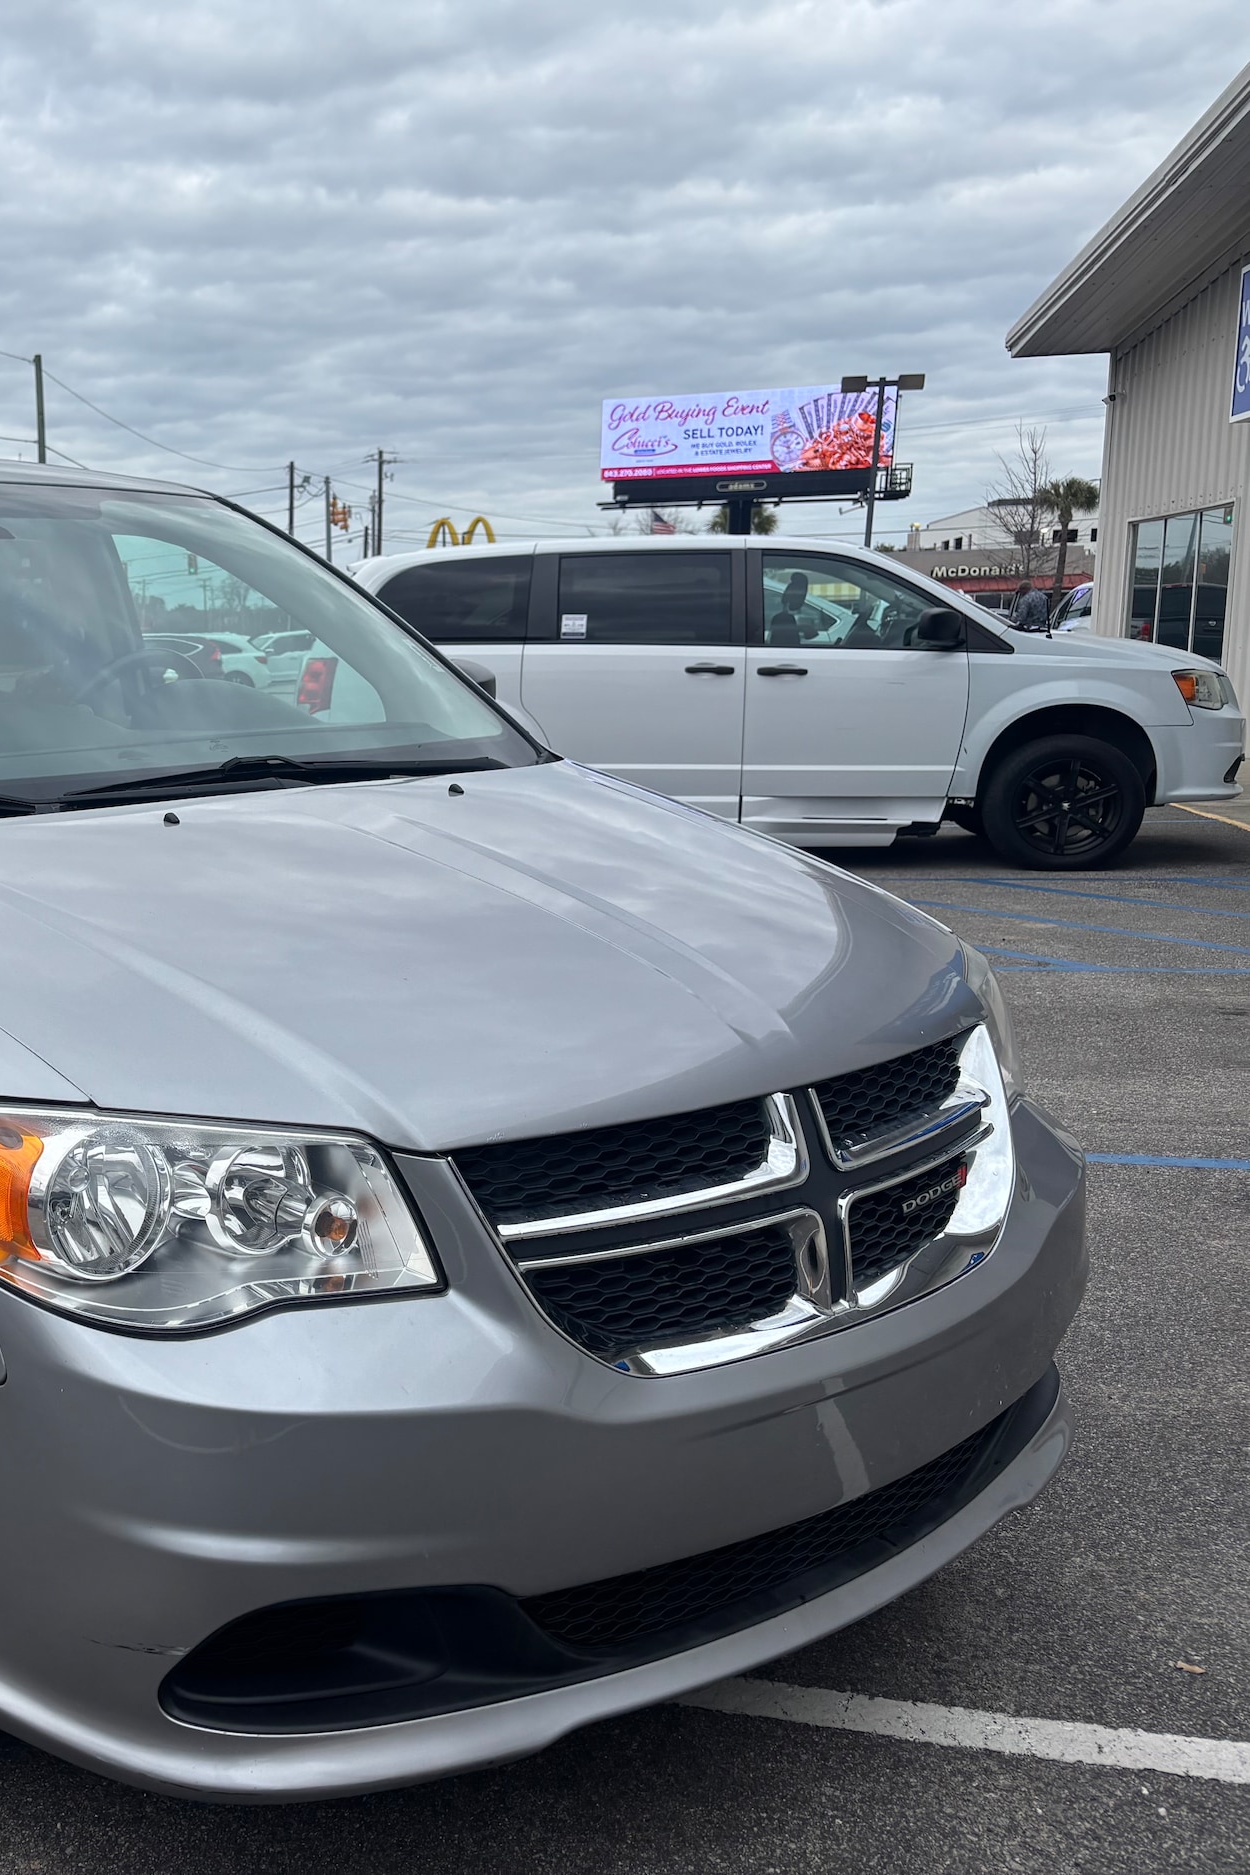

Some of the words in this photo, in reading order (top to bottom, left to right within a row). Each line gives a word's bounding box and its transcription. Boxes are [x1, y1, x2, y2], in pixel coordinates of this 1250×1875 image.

[608, 404, 651, 430] Gold
[653, 401, 717, 428] Buying
[722, 396, 770, 417] Event
[683, 427, 715, 440] SELL
[717, 424, 764, 438] TODAY!
[902, 1174, 962, 1214] DODGE
